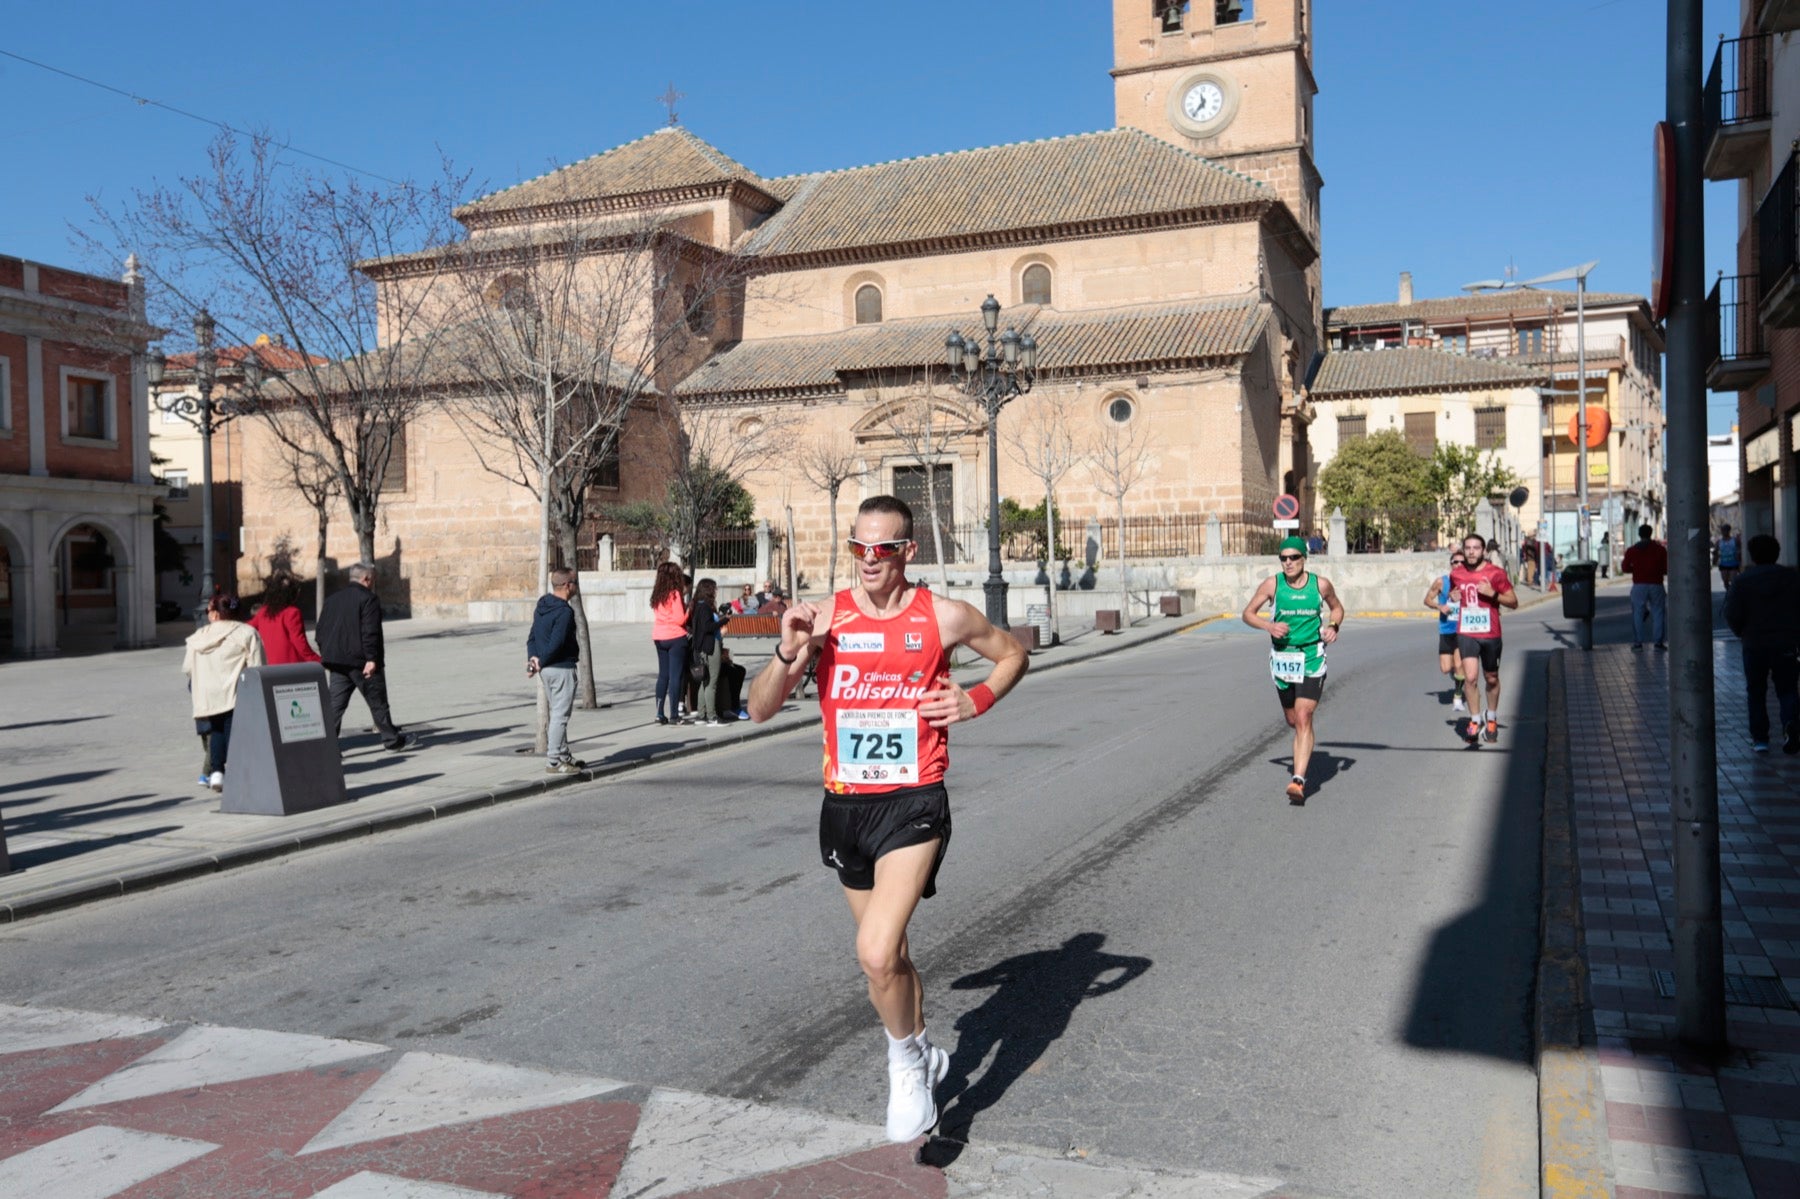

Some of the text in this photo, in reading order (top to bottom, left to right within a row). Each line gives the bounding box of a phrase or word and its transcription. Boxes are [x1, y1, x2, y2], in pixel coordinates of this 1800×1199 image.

[1465, 615, 1487, 624] 1203
[1276, 662, 1301, 672] 1157
[863, 671, 902, 682] Clínicas
[850, 733, 903, 760] 725
